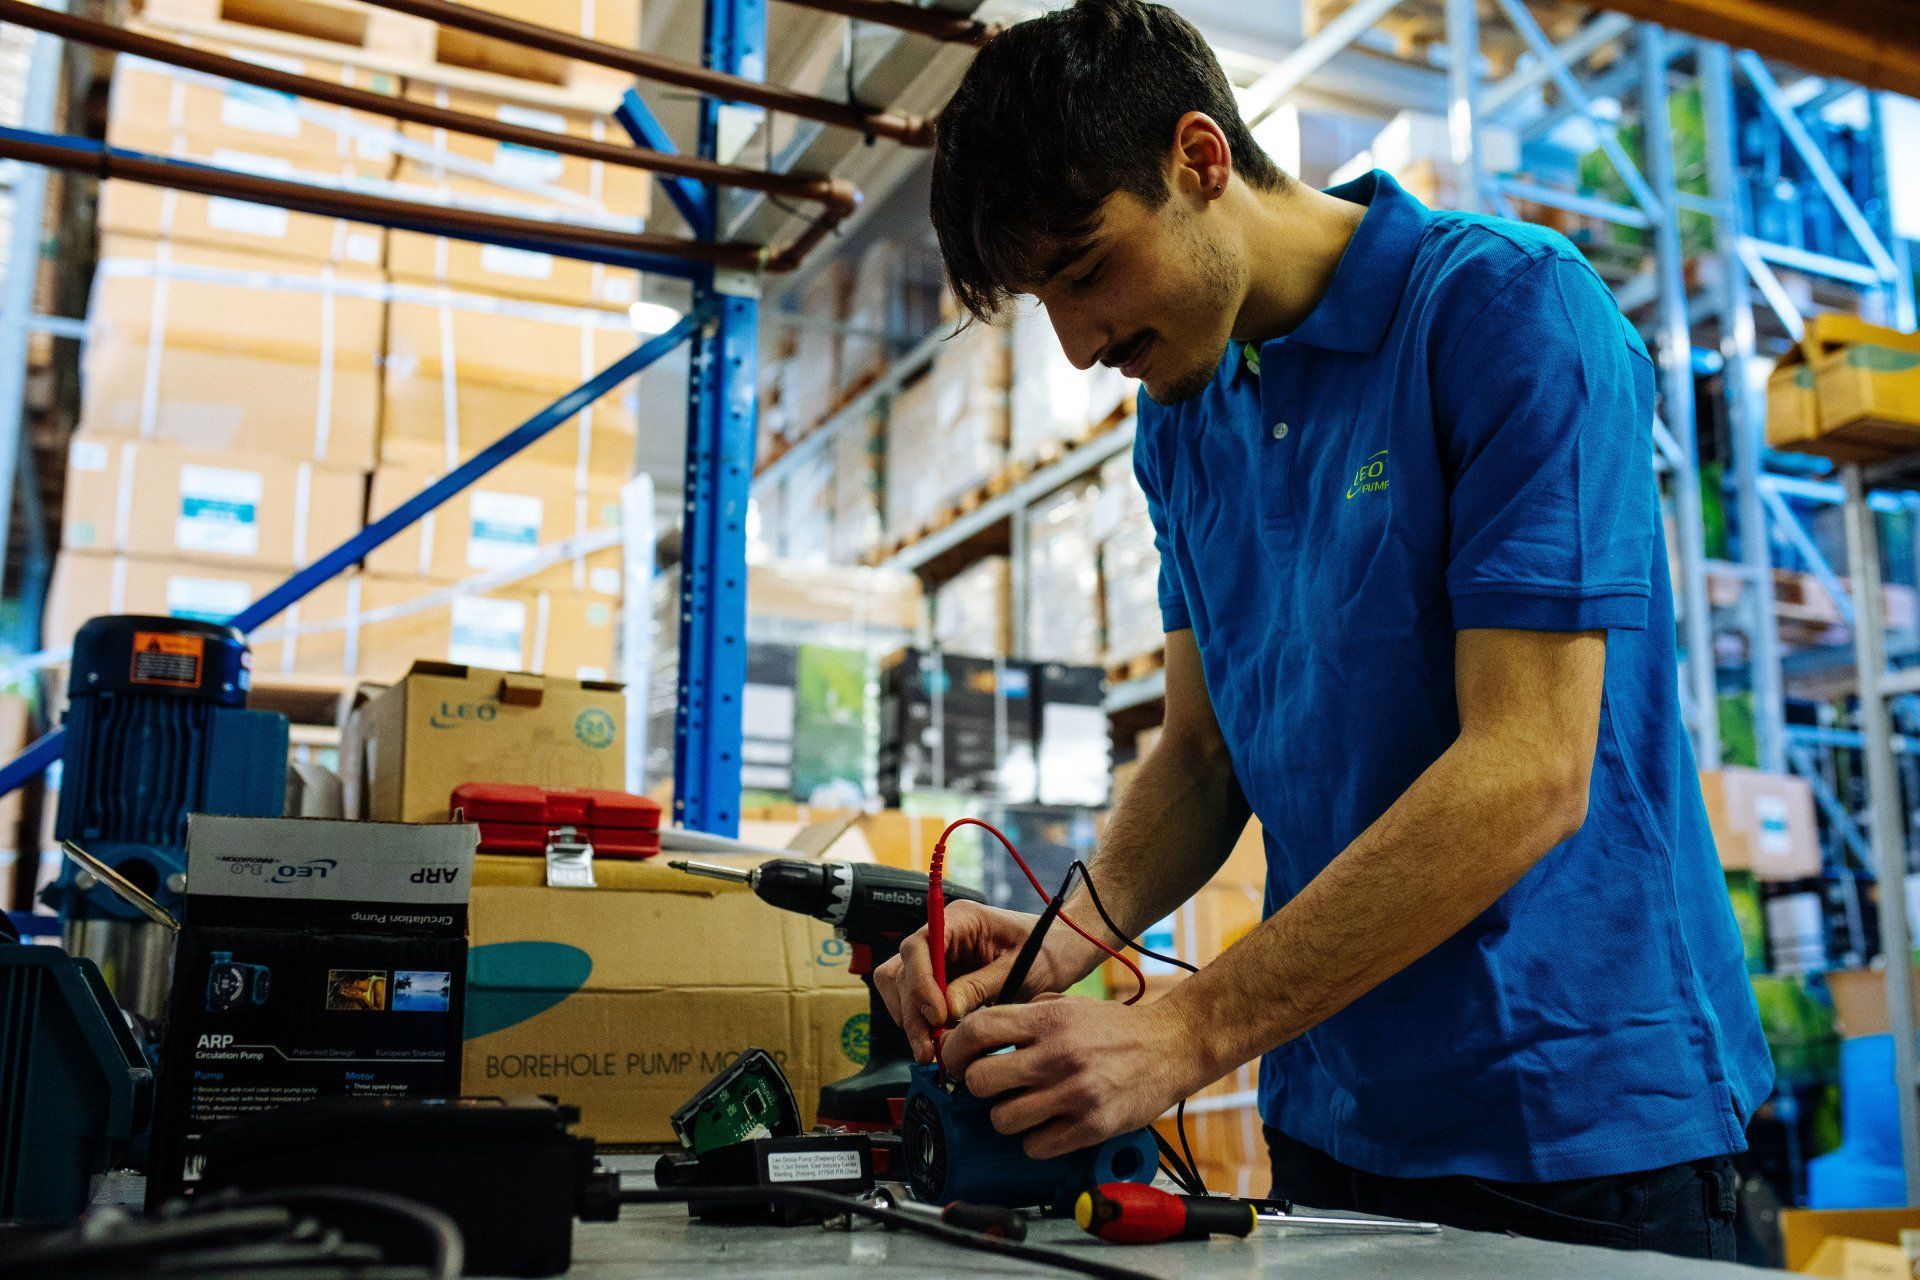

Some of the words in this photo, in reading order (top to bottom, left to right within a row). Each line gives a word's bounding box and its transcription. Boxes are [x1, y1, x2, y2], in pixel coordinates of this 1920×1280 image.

[441, 702, 497, 721] LEO
[410, 867, 459, 883] ARP
[873, 891, 923, 906] metabo
[351, 912, 387, 924] Pump
[390, 914, 453, 925] Circulation
[197, 1034, 234, 1048] ARP
[195, 1050, 239, 1060] Circulation
[240, 1050, 265, 1061] Pump
[293, 1049, 328, 1057] Patented
[329, 1049, 355, 1058] Design
[375, 1049, 411, 1058] European
[412, 1049, 446, 1057] Standard
[487, 1053, 615, 1078] BOREHOLE
[627, 1051, 692, 1075] PUMP
[193, 1071, 224, 1081] Pump
[345, 1071, 375, 1081] Motor
